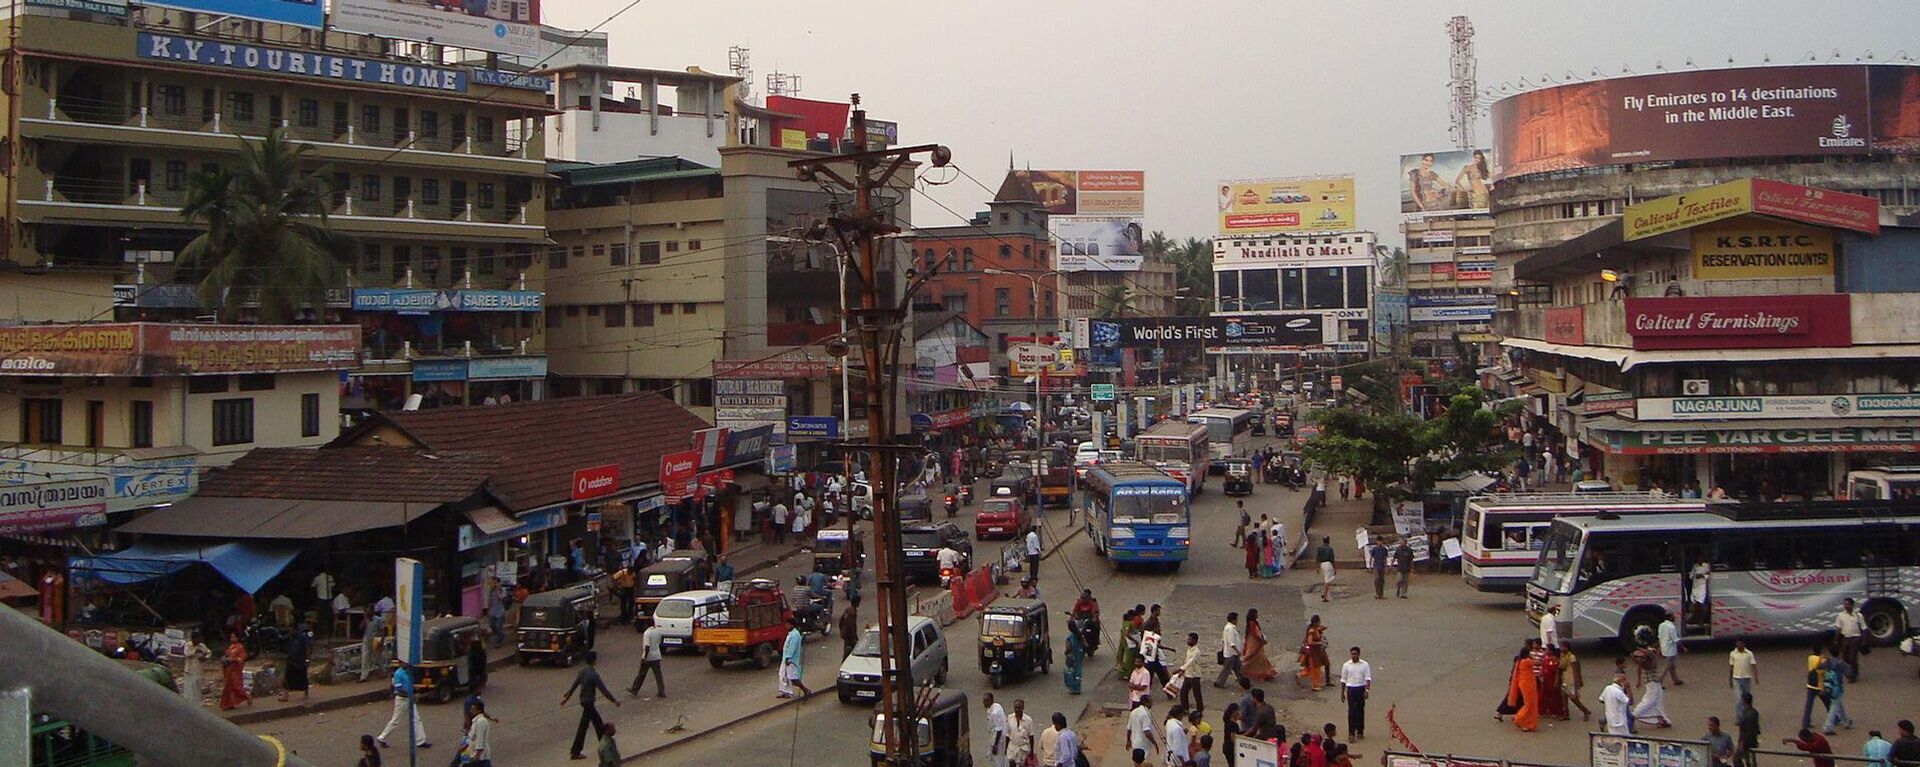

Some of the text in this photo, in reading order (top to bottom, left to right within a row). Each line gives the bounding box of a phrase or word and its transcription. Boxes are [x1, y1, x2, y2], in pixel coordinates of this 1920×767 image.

[380, 62, 456, 89] HOME
[475, 71, 548, 90] K.Y. COMPLEX
[1624, 85, 1838, 110] Fly Emirates to 14 destinations
[1665, 105, 1795, 123] in the Middle East.
[1819, 135, 1865, 148] Emirates
[1758, 190, 1797, 206] Calicut
[1634, 209, 1680, 229] Calicut
[1684, 196, 1740, 217] Textiles
[1717, 235, 1814, 248] K.S.R.T.C.
[1241, 246, 1352, 258] Nandilath G Mart
[1702, 253, 1829, 267] RESERVATION COUNTER
[463, 295, 540, 307] SAREE PALACE
[1636, 311, 1799, 333] Calicut Furnishings
[1133, 325, 1218, 339] World's First
[717, 380, 784, 394] DUBAI MARKET
[1675, 400, 1761, 412] NAGARJUNA
[791, 420, 827, 430] Saravana
[1642, 431, 1707, 444] PEE
[1712, 431, 1772, 443] YAR
[1776, 429, 1855, 442] CEE
[127, 479, 185, 496] VERTEX
[588, 477, 613, 489] vodafone
